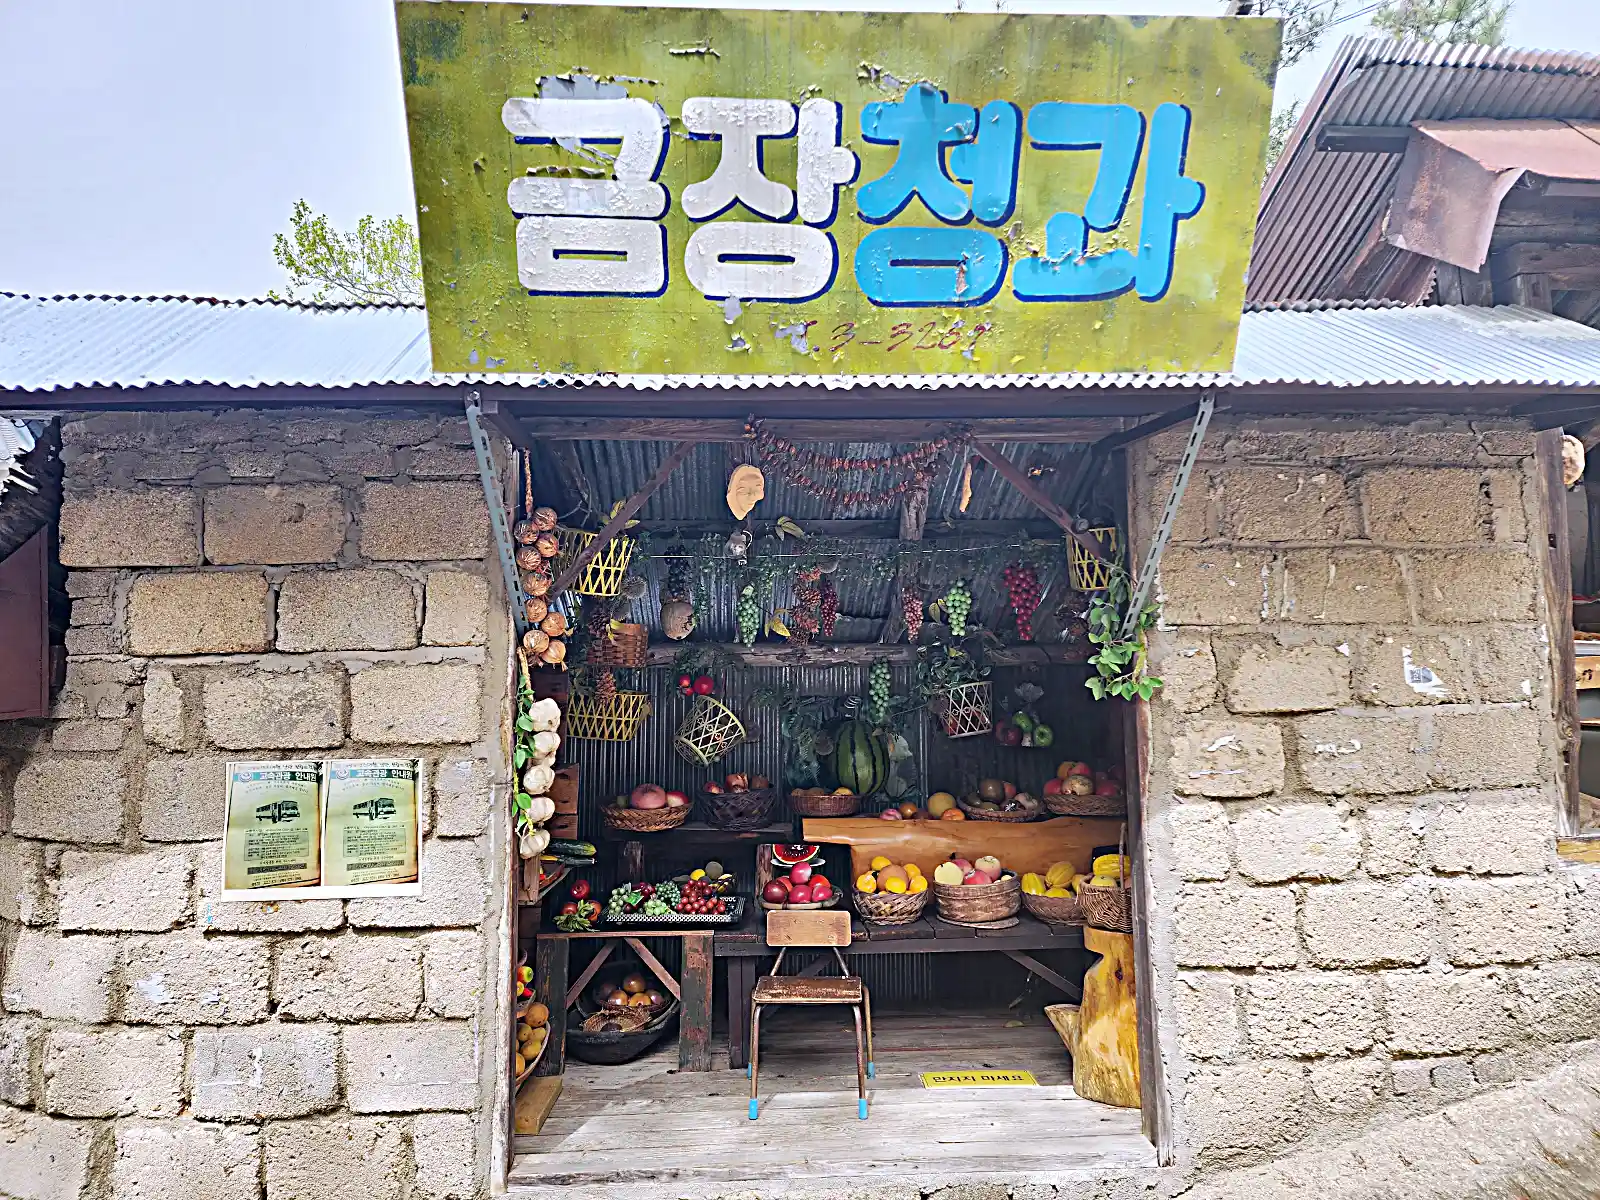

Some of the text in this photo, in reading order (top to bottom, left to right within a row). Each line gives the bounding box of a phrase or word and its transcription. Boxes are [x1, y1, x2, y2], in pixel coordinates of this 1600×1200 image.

[501, 82, 1206, 307] 금장청과
[259, 771, 317, 782] 고속관광 안내원
[355, 769, 413, 780] 고속관광 안내원
[932, 1075, 977, 1083] 만지지
